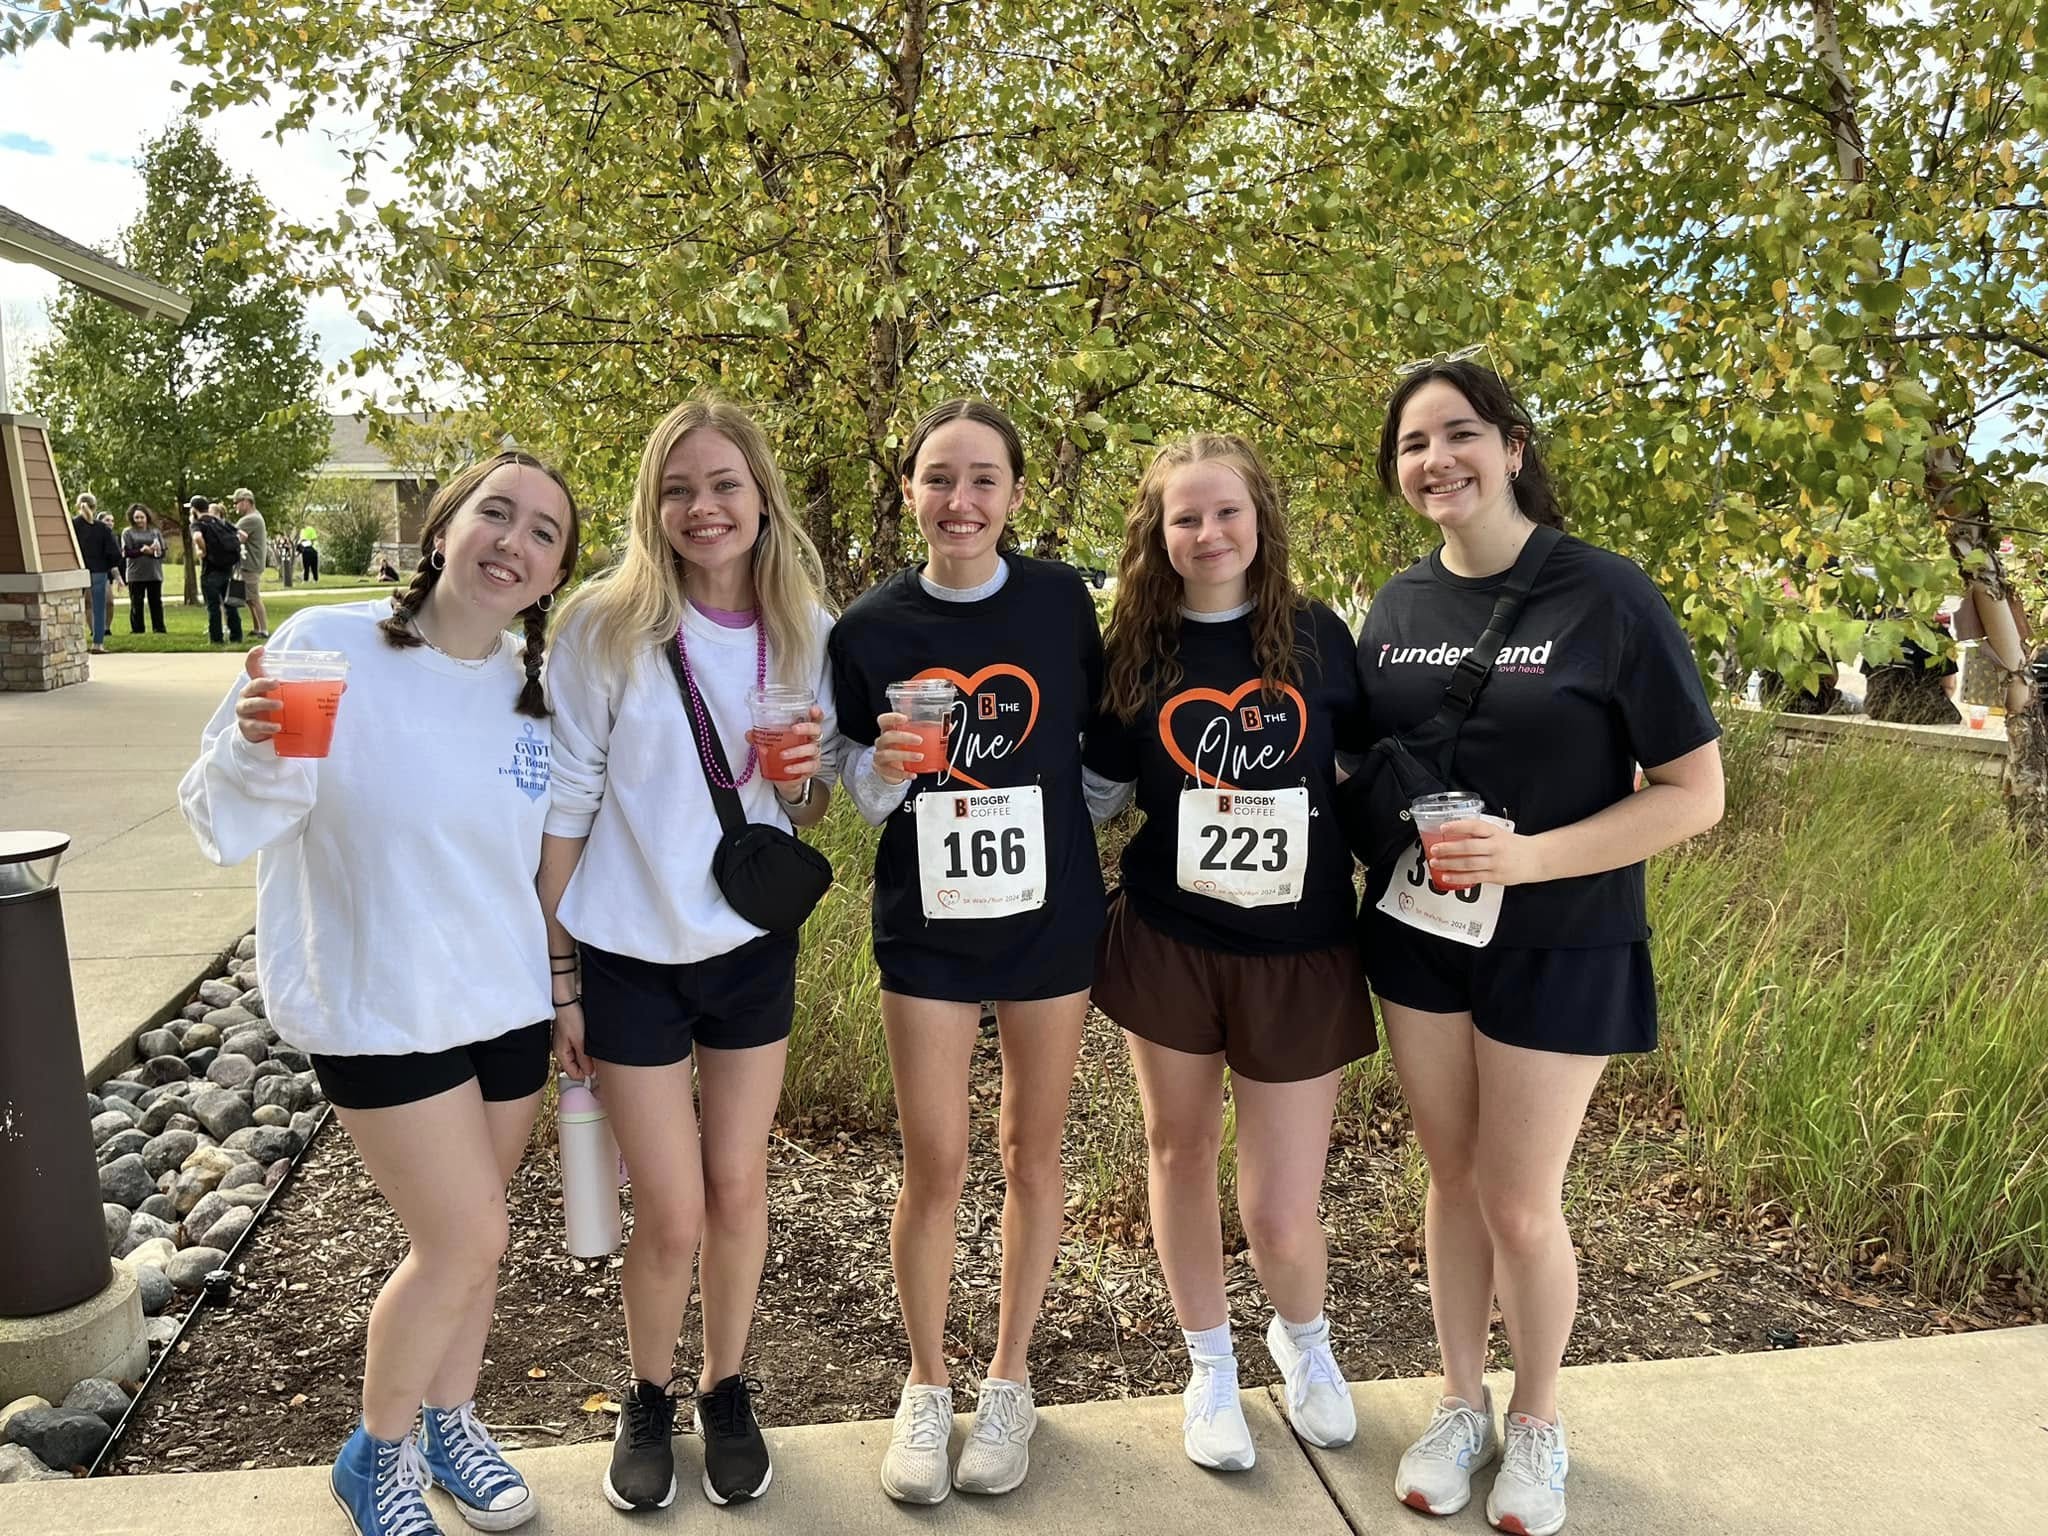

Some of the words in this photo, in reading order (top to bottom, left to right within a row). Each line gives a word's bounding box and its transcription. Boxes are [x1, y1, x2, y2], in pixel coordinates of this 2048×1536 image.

[1391, 640, 1553, 666] underand
[1518, 664, 1545, 675] heals
[998, 702, 1021, 713] THE
[1263, 712, 1288, 723] THE
[1195, 715, 1285, 789] One
[970, 795, 1010, 806] BIGGBY
[1234, 795, 1276, 806] BIGGBY
[970, 806, 1011, 818] COFFEE
[1234, 807, 1276, 817] COFFEE
[944, 827, 1026, 879] 166
[1199, 825, 1288, 872] 223
[1450, 920, 1467, 930] 2024
